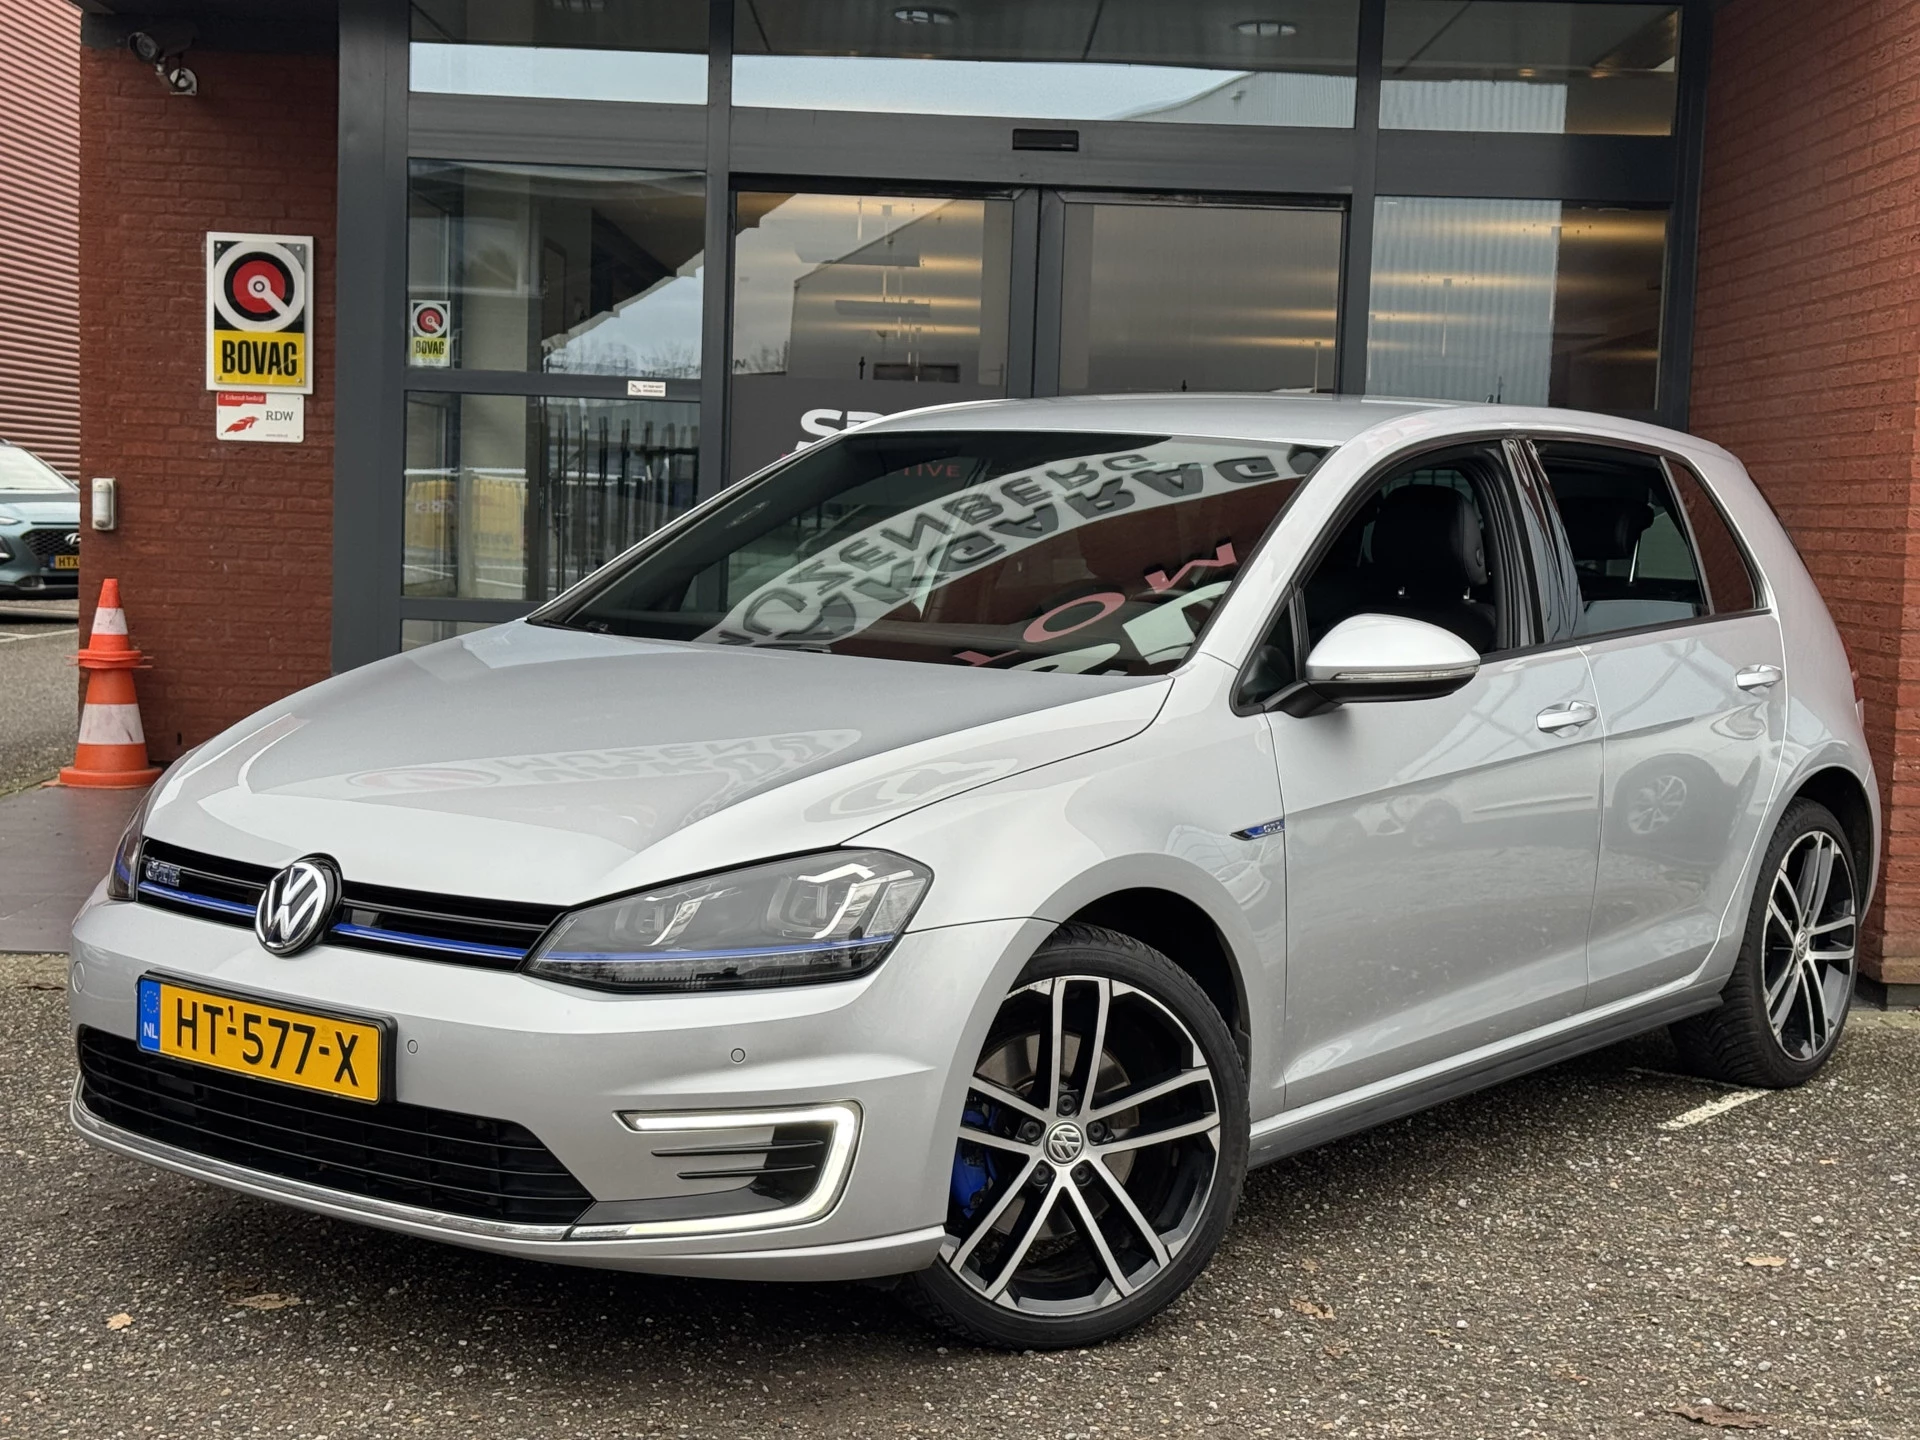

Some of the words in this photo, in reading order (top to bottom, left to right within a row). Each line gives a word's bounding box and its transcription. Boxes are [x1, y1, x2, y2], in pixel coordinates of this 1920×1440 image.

[222, 340, 297, 376] BOVAG
[415, 341, 445, 355] BOVAG
[265, 411, 294, 421] RDW
[146, 861, 179, 887] GTE
[143, 1022, 158, 1039] NL
[176, 997, 359, 1087] HT-577-X
